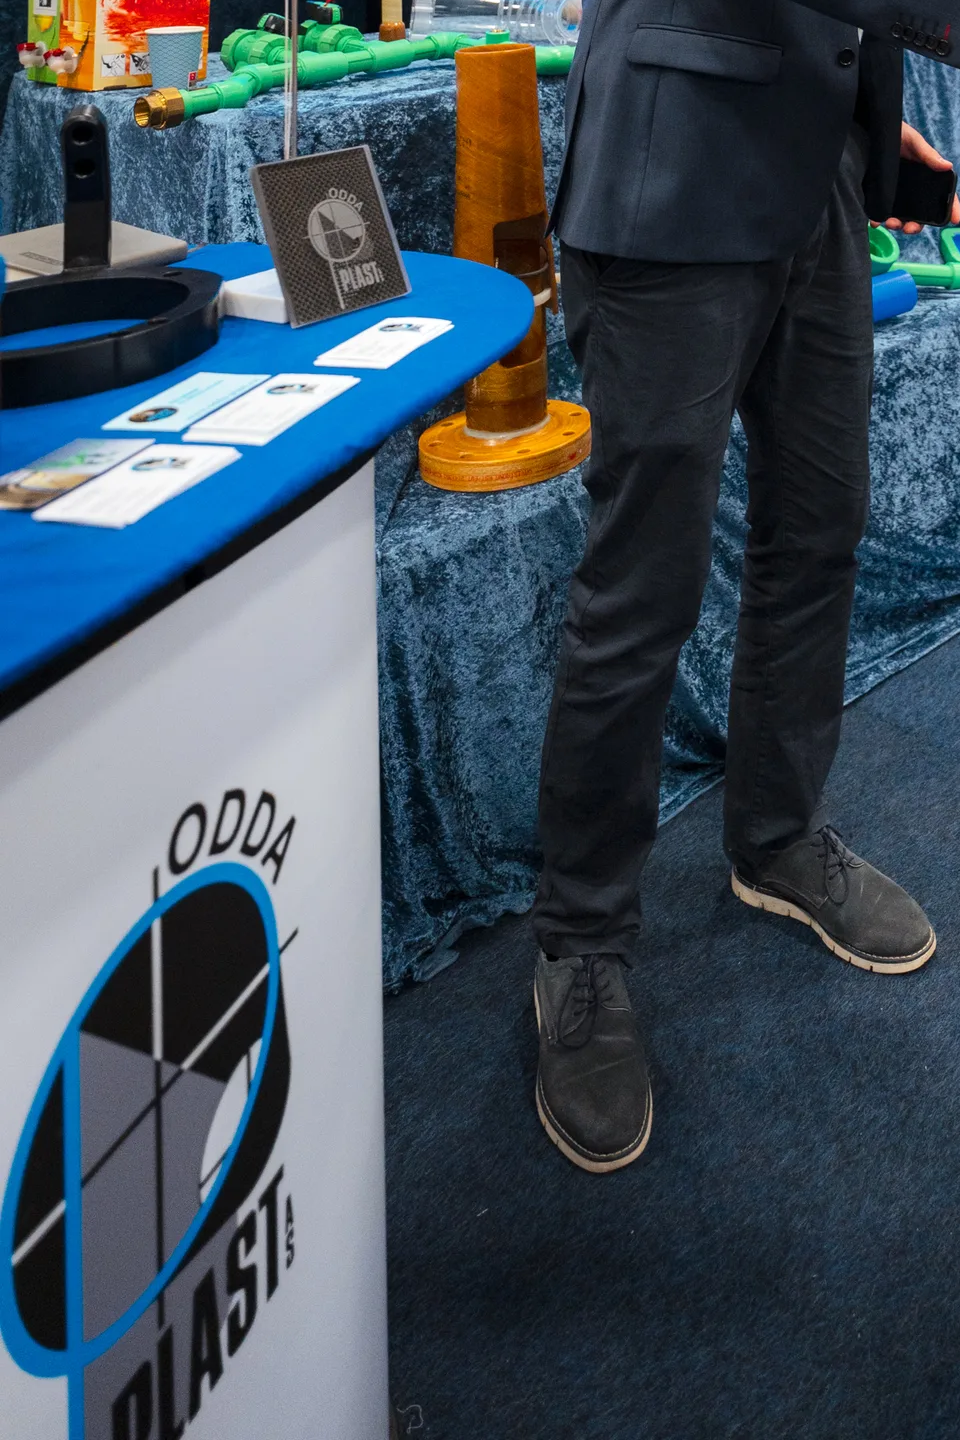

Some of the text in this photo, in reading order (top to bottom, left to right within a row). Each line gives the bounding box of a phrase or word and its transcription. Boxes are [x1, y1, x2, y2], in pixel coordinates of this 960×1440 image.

[328, 187, 364, 212] ODDA
[338, 261, 380, 293] PLAST
[168, 787, 297, 885] ODDA
